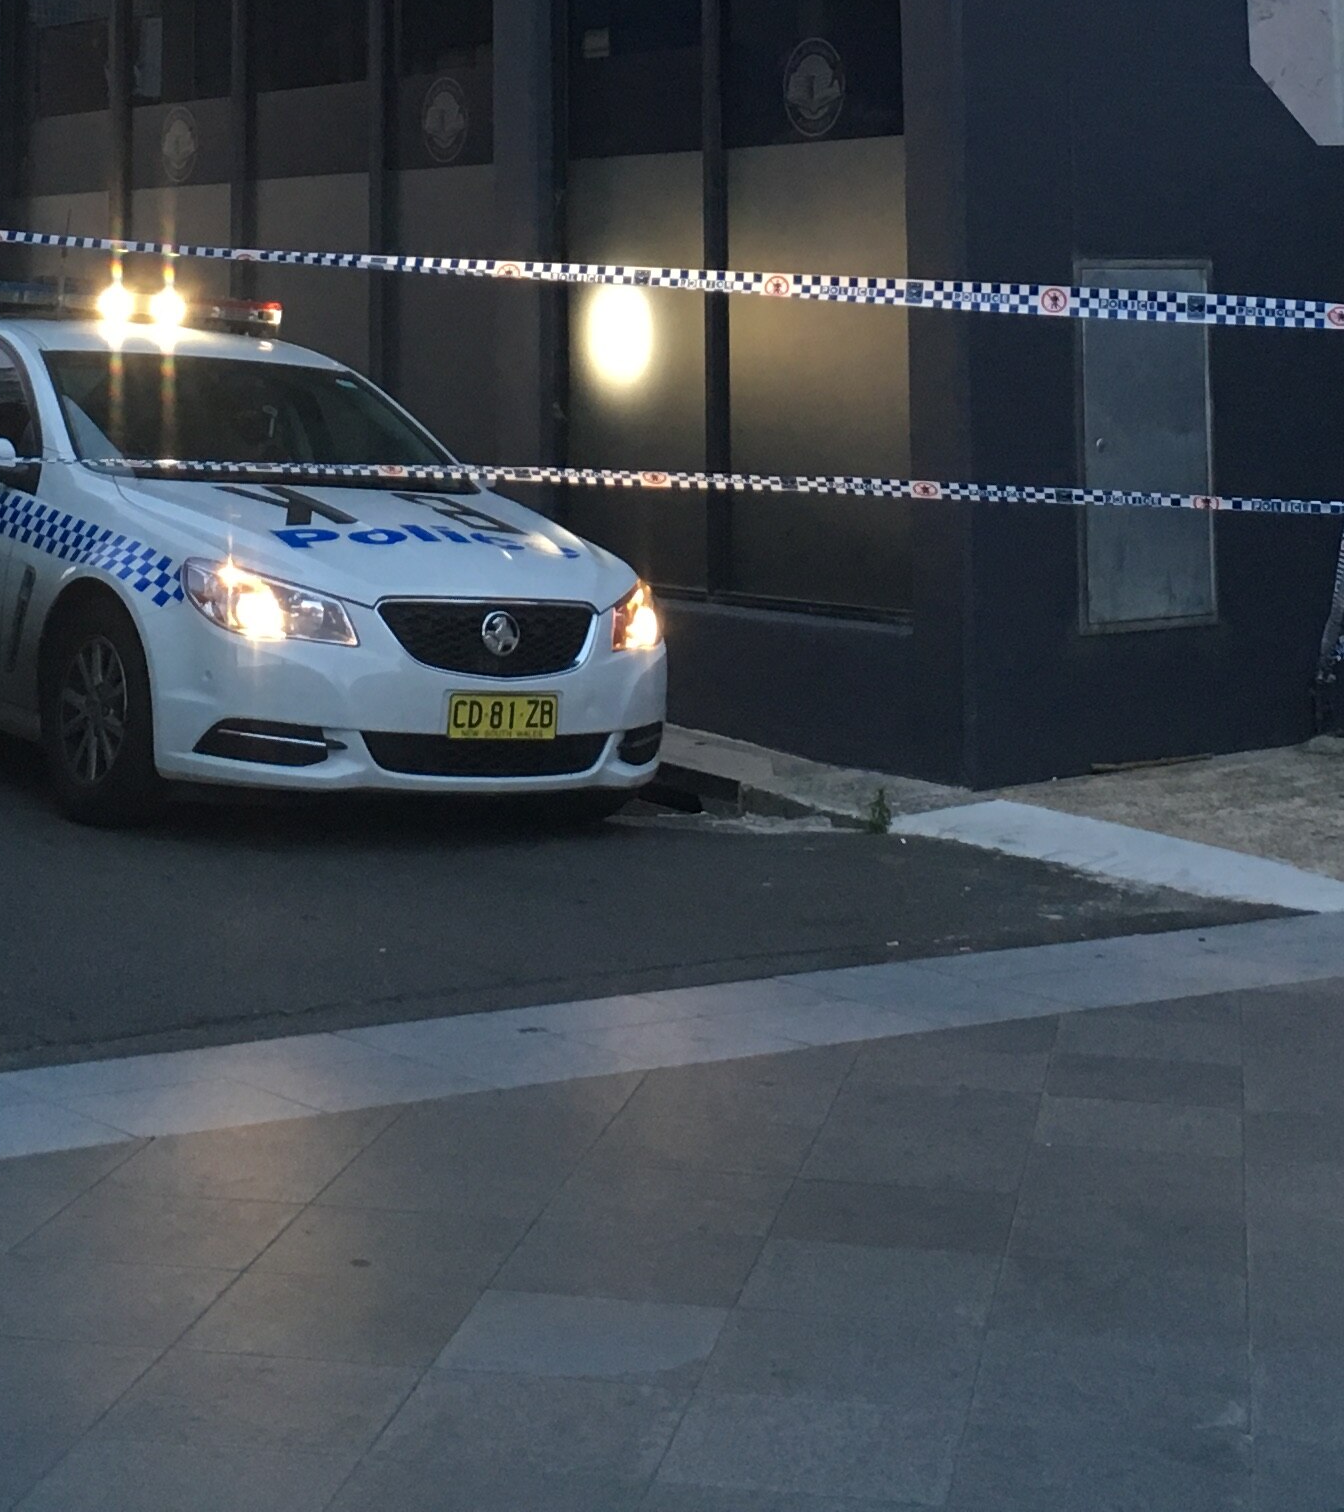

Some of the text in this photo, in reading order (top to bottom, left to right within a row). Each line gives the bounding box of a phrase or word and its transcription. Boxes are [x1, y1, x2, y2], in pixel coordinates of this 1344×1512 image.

[820, 286, 875, 297] POLICE
[953, 293, 1010, 304] POLICE
[1099, 299, 1157, 311] POLICE
[453, 699, 554, 730] CD 81 ZB
